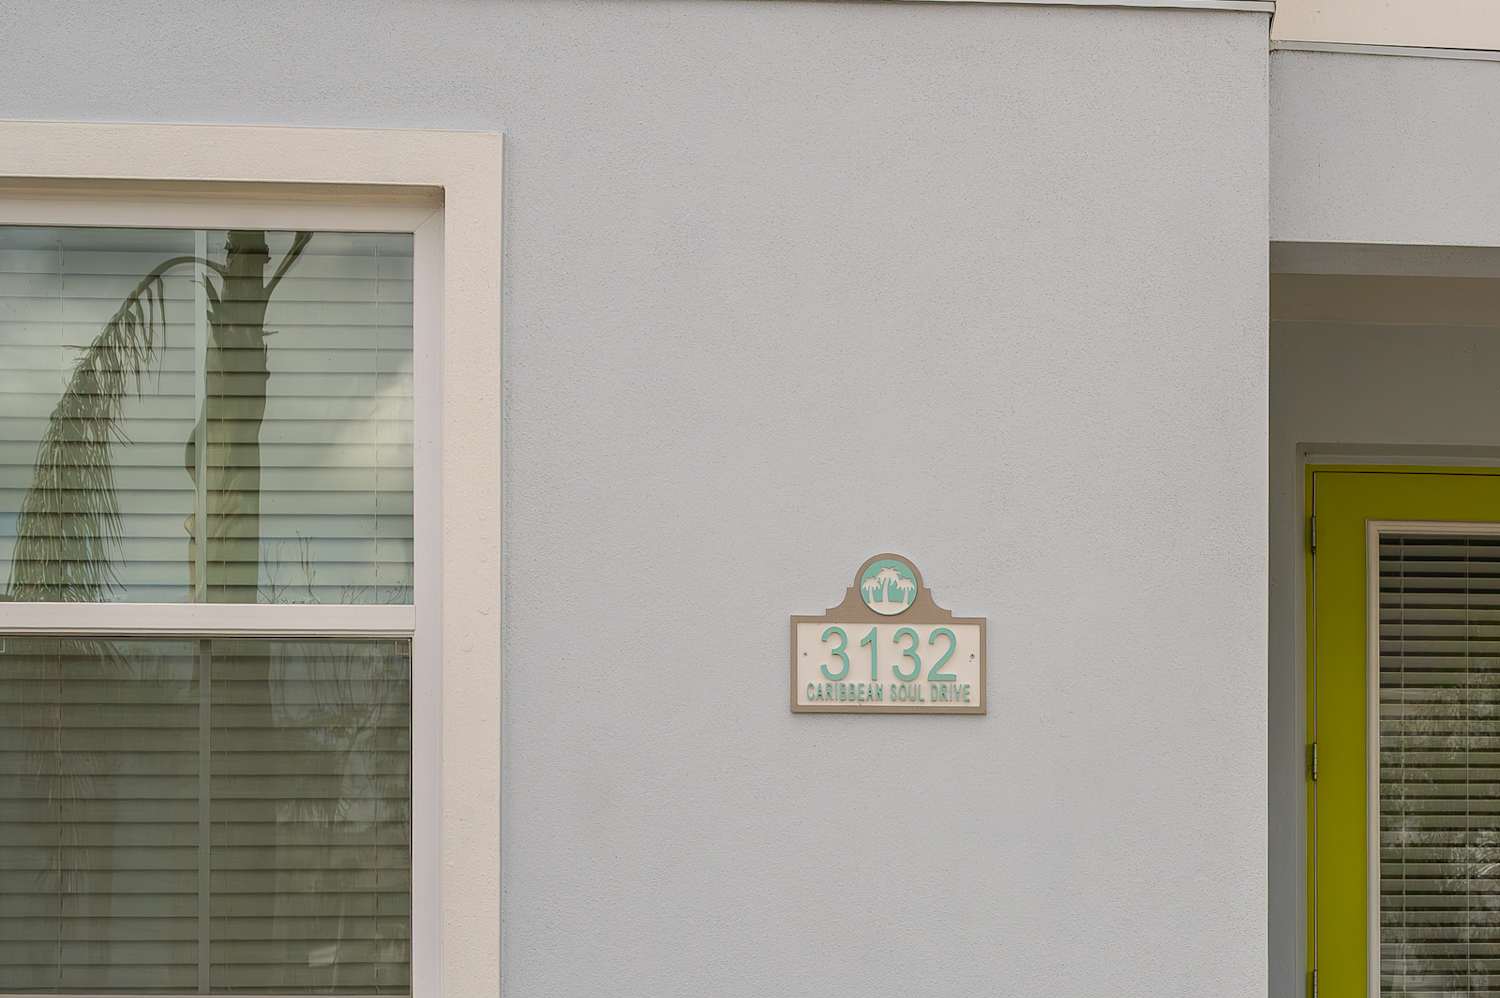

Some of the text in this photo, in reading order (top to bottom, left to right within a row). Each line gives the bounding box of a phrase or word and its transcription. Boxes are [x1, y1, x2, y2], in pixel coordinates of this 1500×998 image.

[820, 626, 957, 681] 3132
[806, 683, 971, 703] CARIBBEAN SOUL DRIVE
